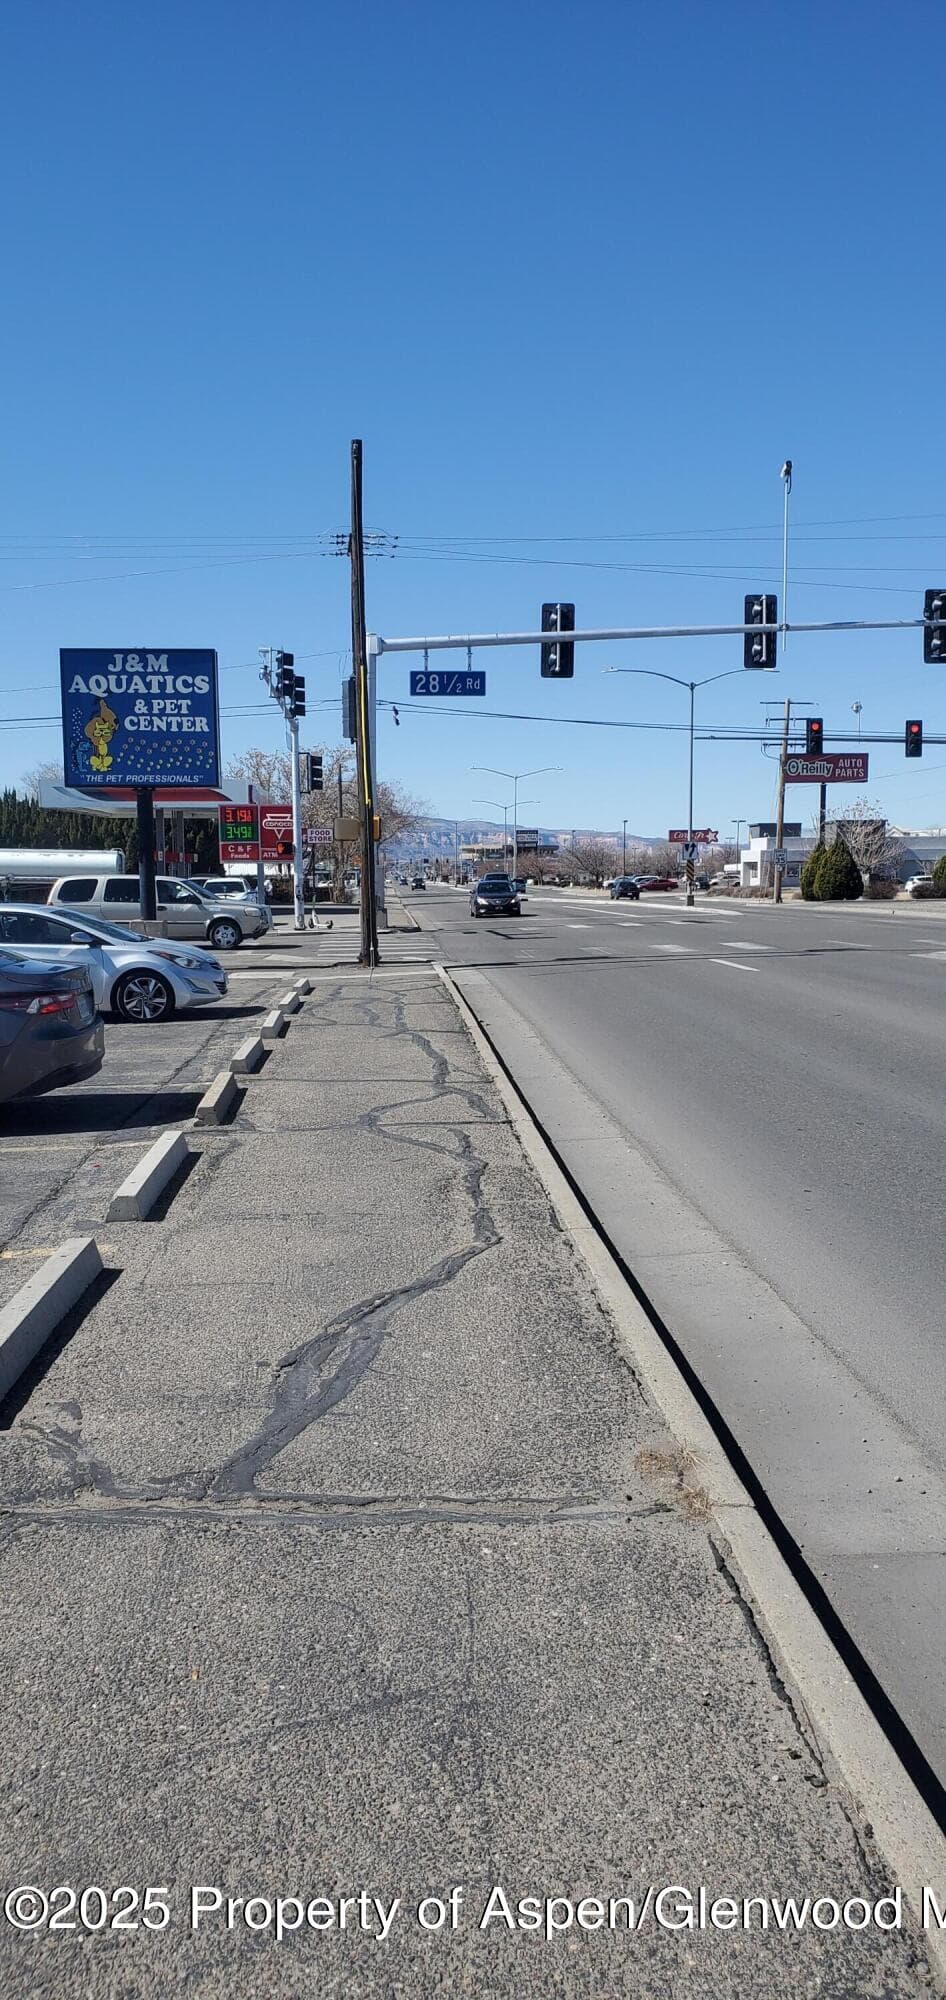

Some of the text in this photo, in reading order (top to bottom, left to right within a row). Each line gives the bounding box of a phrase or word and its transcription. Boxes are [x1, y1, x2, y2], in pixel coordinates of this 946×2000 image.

[108, 654, 169, 673] J&M
[68, 674, 210, 697] AQUATICS
[415, 674, 440, 693] 28
[466, 678, 480, 690] Rd
[134, 699, 192, 714] & PET
[124, 716, 210, 732] CENTER
[787, 758, 834, 777] O'Reilly
[838, 758, 863, 768] AUTO
[106, 774, 122, 783] PET
[835, 768, 865, 777] PARTS
